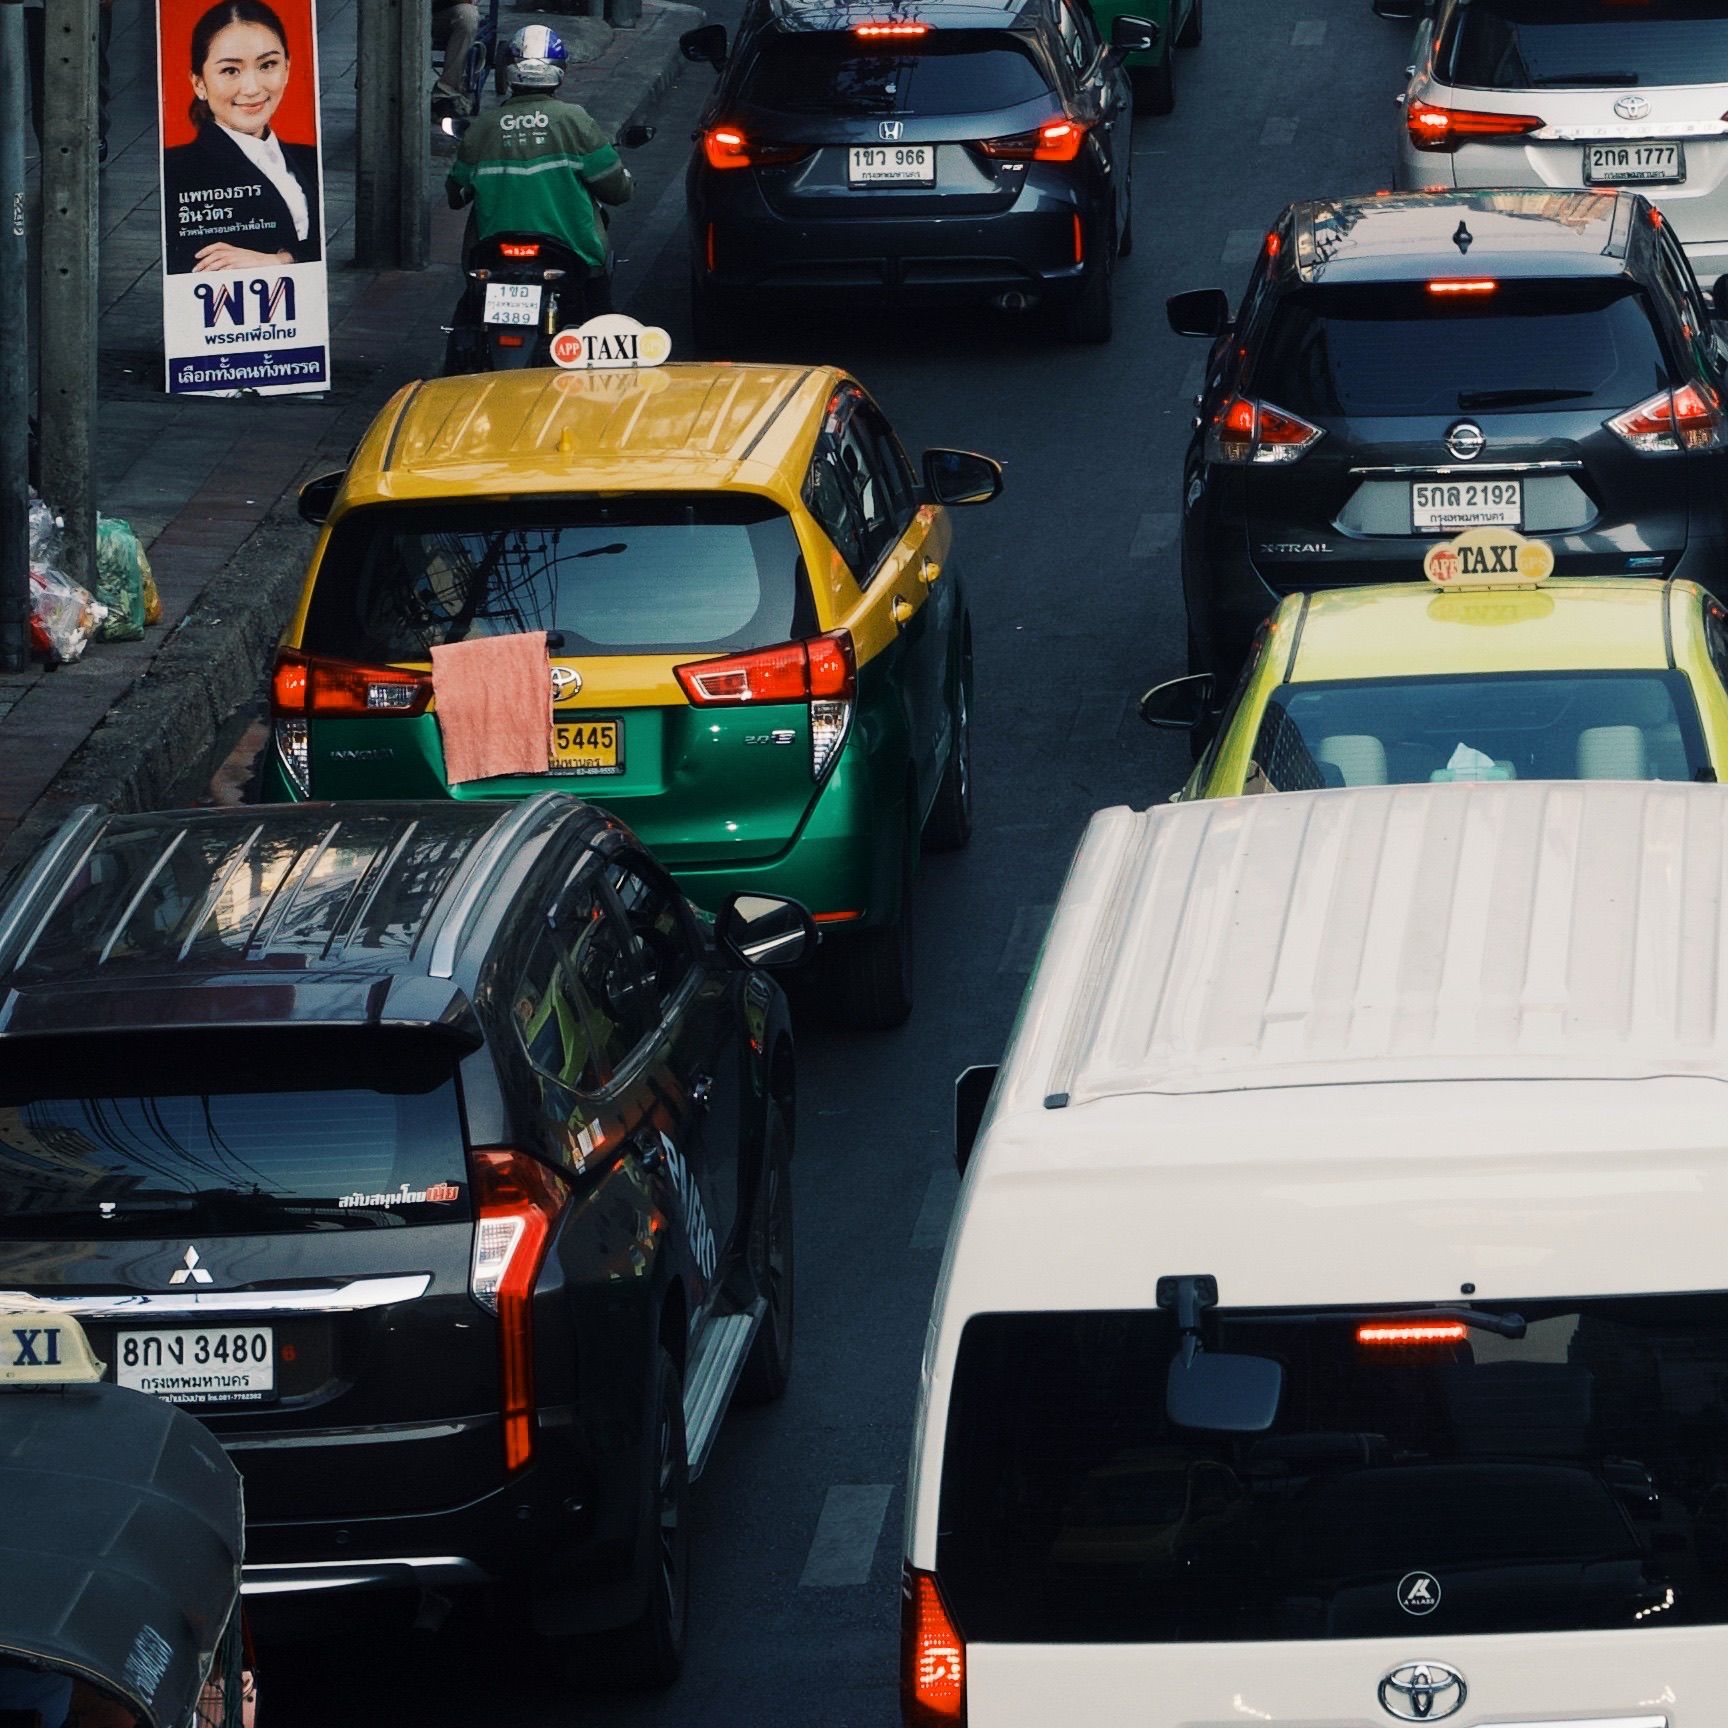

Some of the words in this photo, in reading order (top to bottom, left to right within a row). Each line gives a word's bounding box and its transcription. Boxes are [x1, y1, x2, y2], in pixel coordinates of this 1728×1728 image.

[499, 110, 549, 131] Grab
[895, 149, 926, 166] 966
[1634, 147, 1675, 165] 1777
[178, 183, 262, 204] แพทองธาร
[178, 204, 234, 224] ชินวัตร
[193, 276, 297, 328] พท
[491, 311, 531, 324] 4389
[204, 324, 297, 345] พรรคเพื่อไทย
[558, 342, 580, 356] APP
[582, 335, 638, 360] TAXI
[178, 351, 320, 384] เลือกทั้งคนทั้งพรรค
[1416, 486, 1461, 508] 5กล
[1466, 484, 1518, 506] 2192
[1260, 543, 1334, 553] X-TRAIL
[1457, 545, 1518, 574] TAXI
[555, 725, 614, 751] 5445
[122, 1335, 185, 1367] 8กง
[194, 1333, 268, 1364] 3480
[140, 1374, 250, 1394] กรุงเทพมหานคร
